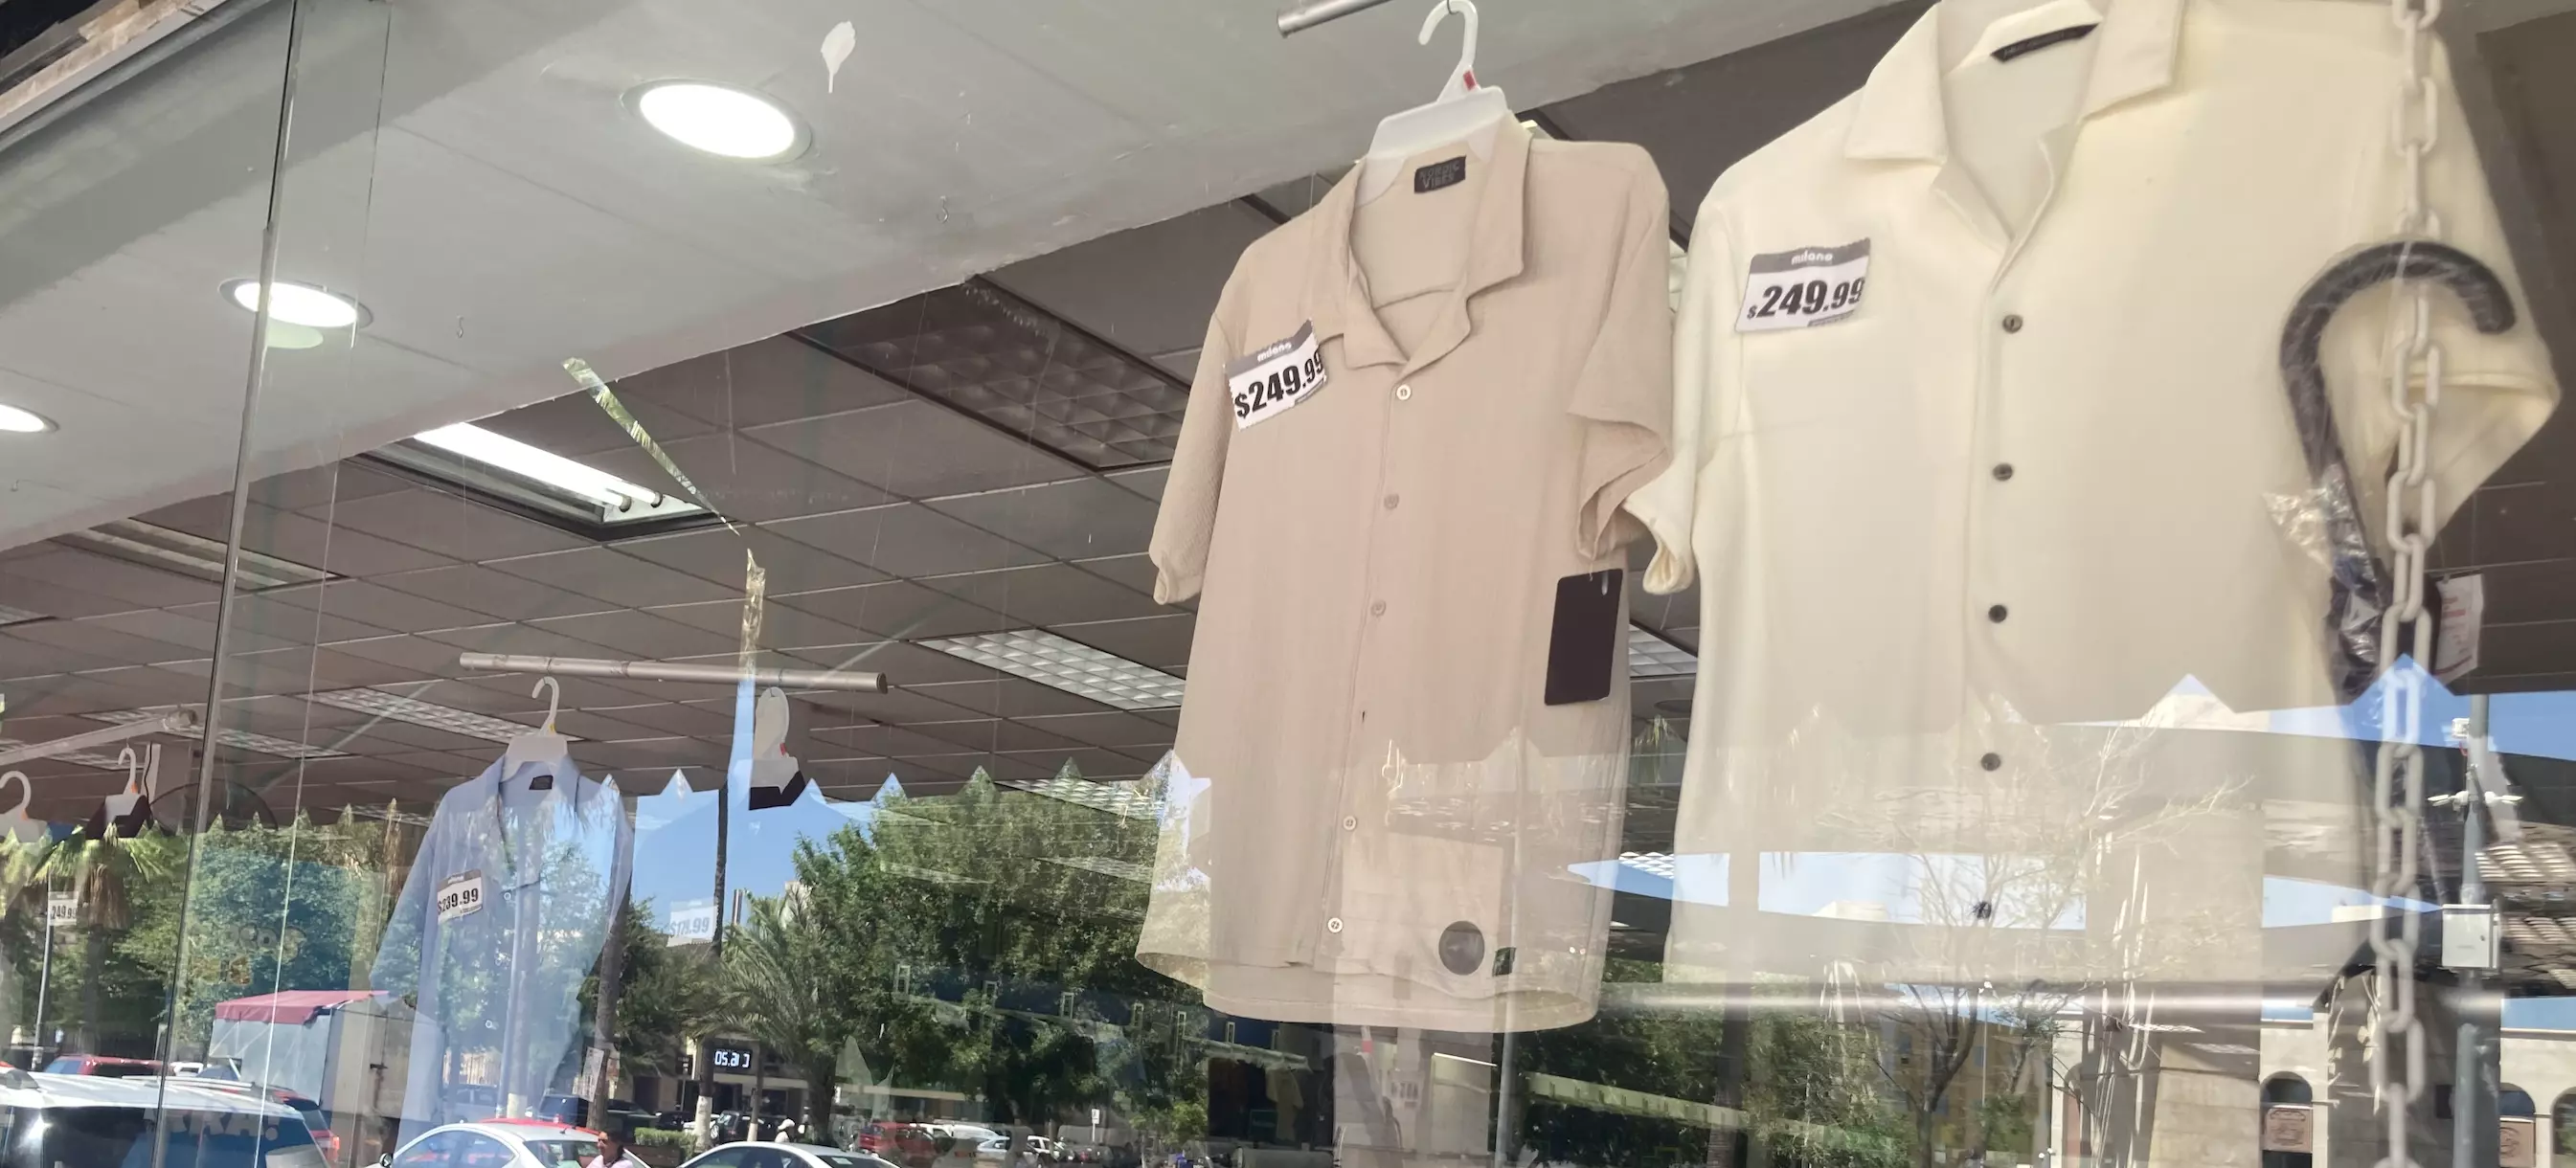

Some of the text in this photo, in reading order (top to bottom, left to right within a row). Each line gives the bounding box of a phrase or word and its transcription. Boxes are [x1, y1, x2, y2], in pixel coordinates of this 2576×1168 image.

[1791, 249, 1833, 265] milano
[1747, 277, 1865, 319] $249.99
[1256, 342, 1292, 362] milano
[1234, 350, 1323, 418] $249.99
[438, 887, 479, 915] $239.99
